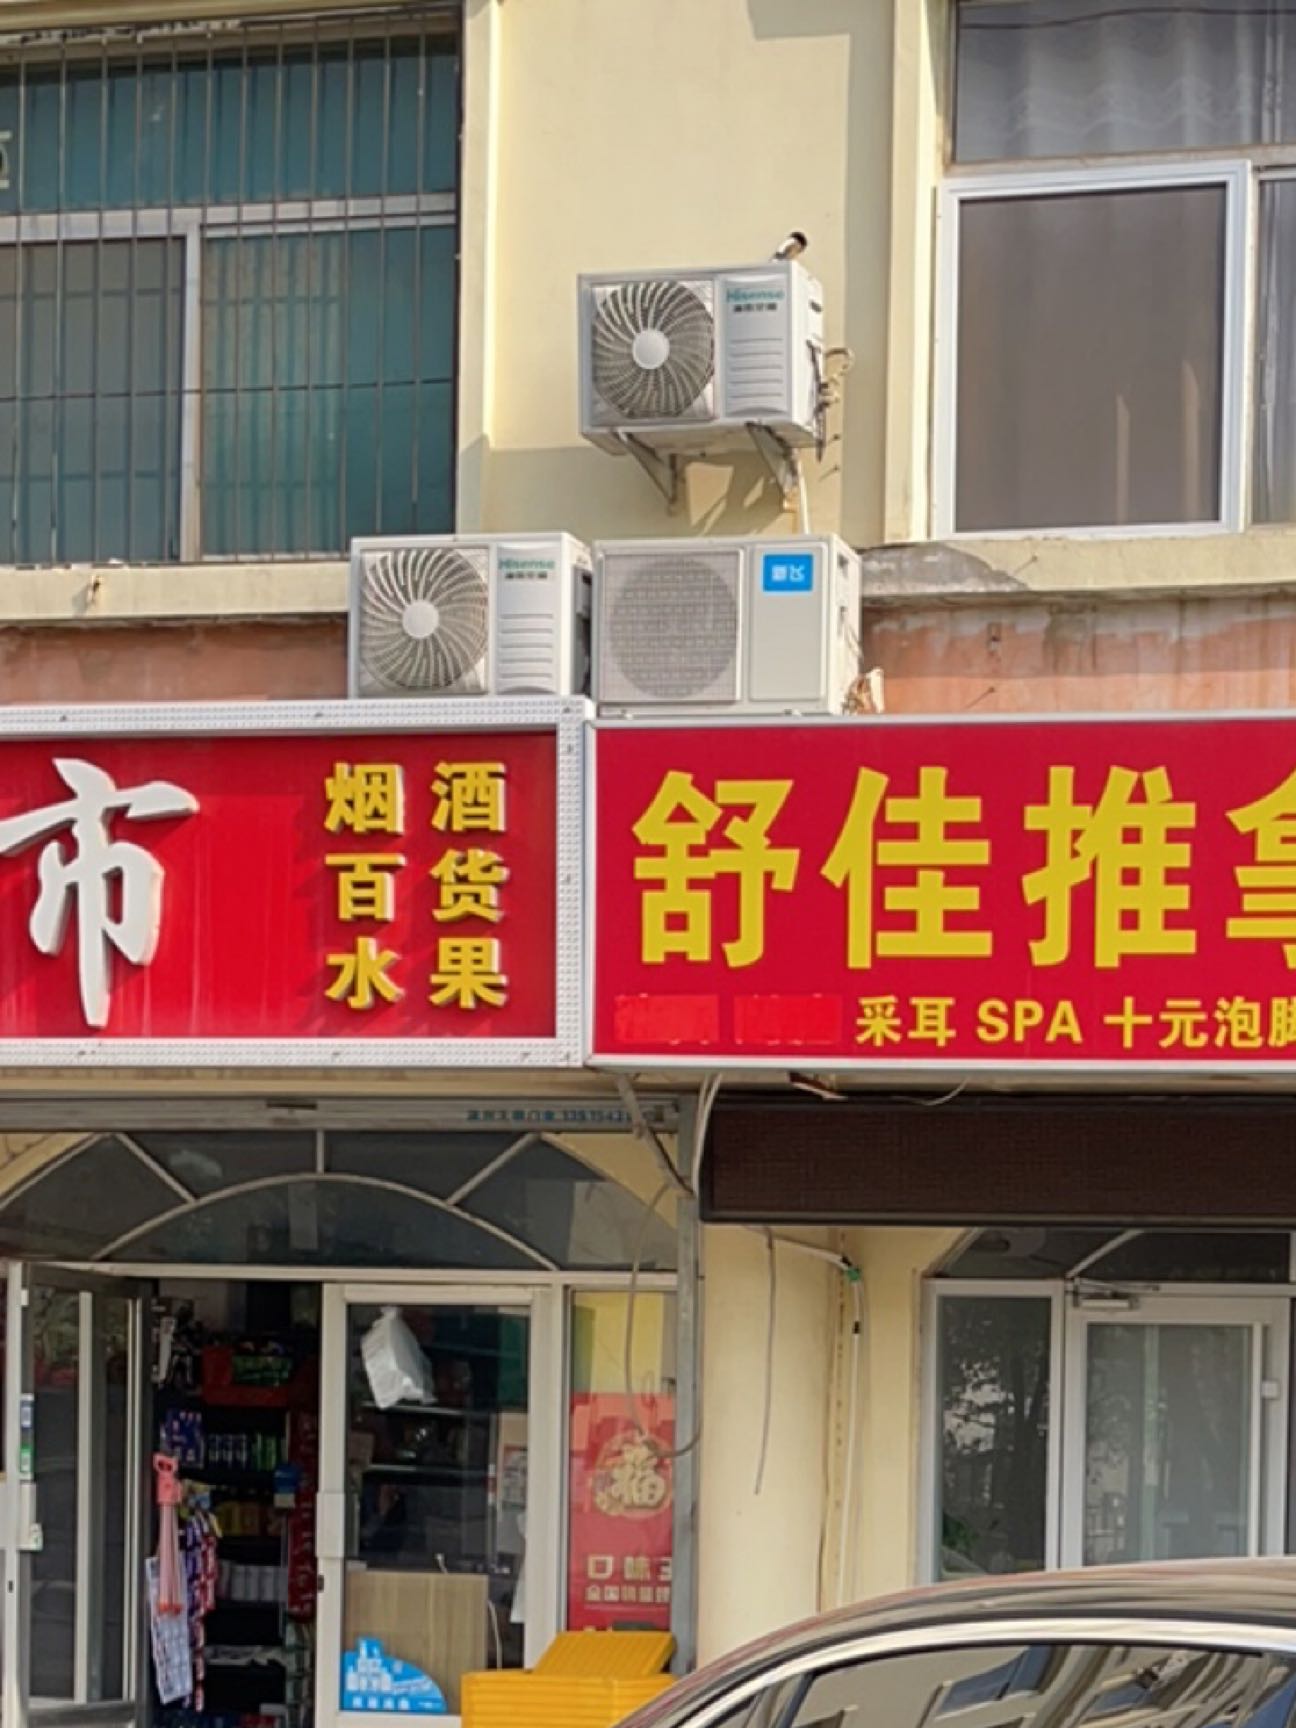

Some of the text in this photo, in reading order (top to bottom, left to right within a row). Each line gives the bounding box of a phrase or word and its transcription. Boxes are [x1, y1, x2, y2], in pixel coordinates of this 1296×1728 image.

[324, 761, 507, 834] 烟酒
[0, 757, 199, 1027] 市
[323, 848, 507, 923] 百货
[324, 936, 508, 1010] 水果
[855, 995, 957, 1047] 采耳
[976, 999, 1083, 1044] SPA
